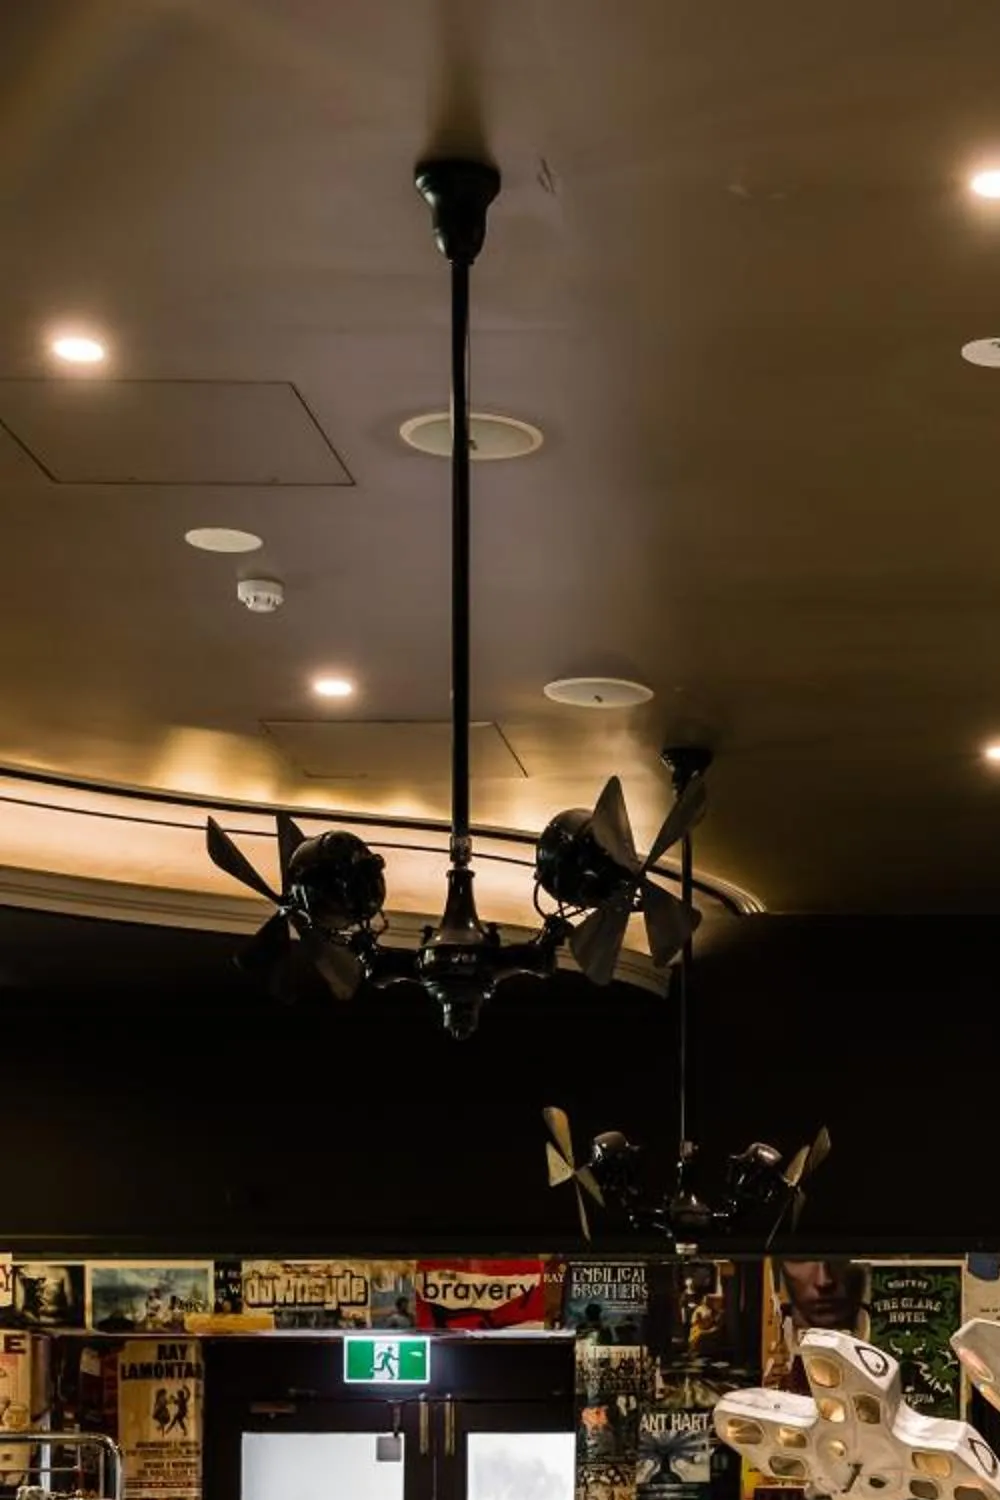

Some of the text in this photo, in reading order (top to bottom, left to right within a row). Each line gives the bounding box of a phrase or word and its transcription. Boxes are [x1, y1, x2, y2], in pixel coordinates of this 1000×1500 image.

[422, 1271, 536, 1308] bravery
[571, 1283, 649, 1299] BROTHERS
[873, 1296, 942, 1313] THE CLARE
[888, 1311, 929, 1323] HOTEL
[157, 1344, 189, 1360] RAY
[639, 1413, 709, 1433] ANT HART
